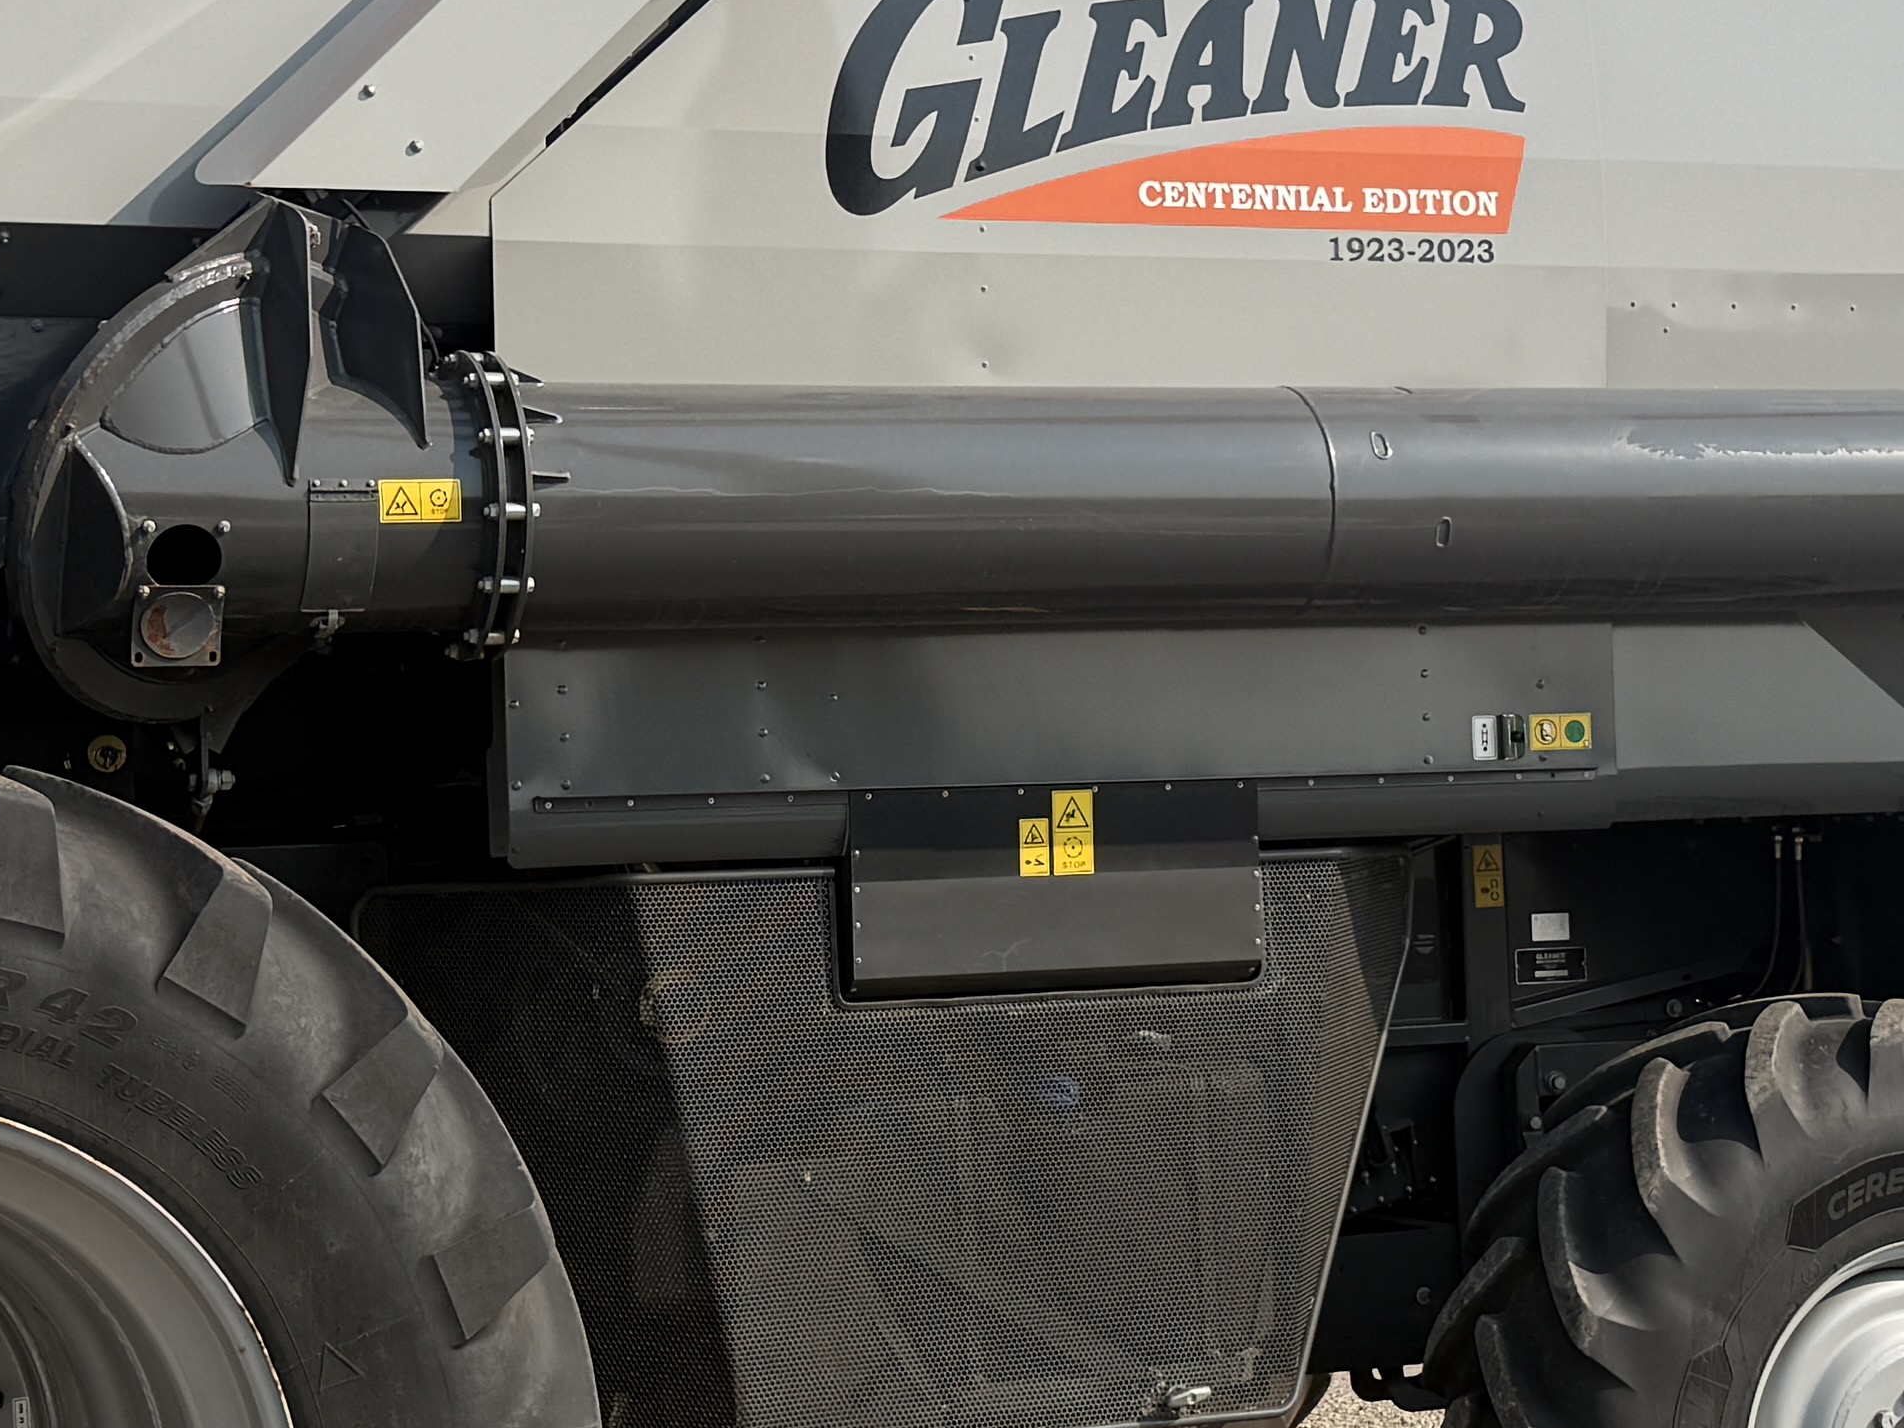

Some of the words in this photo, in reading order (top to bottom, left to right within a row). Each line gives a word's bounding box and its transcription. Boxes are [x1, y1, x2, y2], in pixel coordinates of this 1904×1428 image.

[1139, 180, 1353, 213] CENTENNIAL
[1362, 187, 1498, 217] EDITION
[1329, 236, 1495, 264] 1923-2023
[1062, 860, 1086, 869] STOP
[36, 987, 139, 1050] 42
[98, 1063, 264, 1191] TUBELESS
